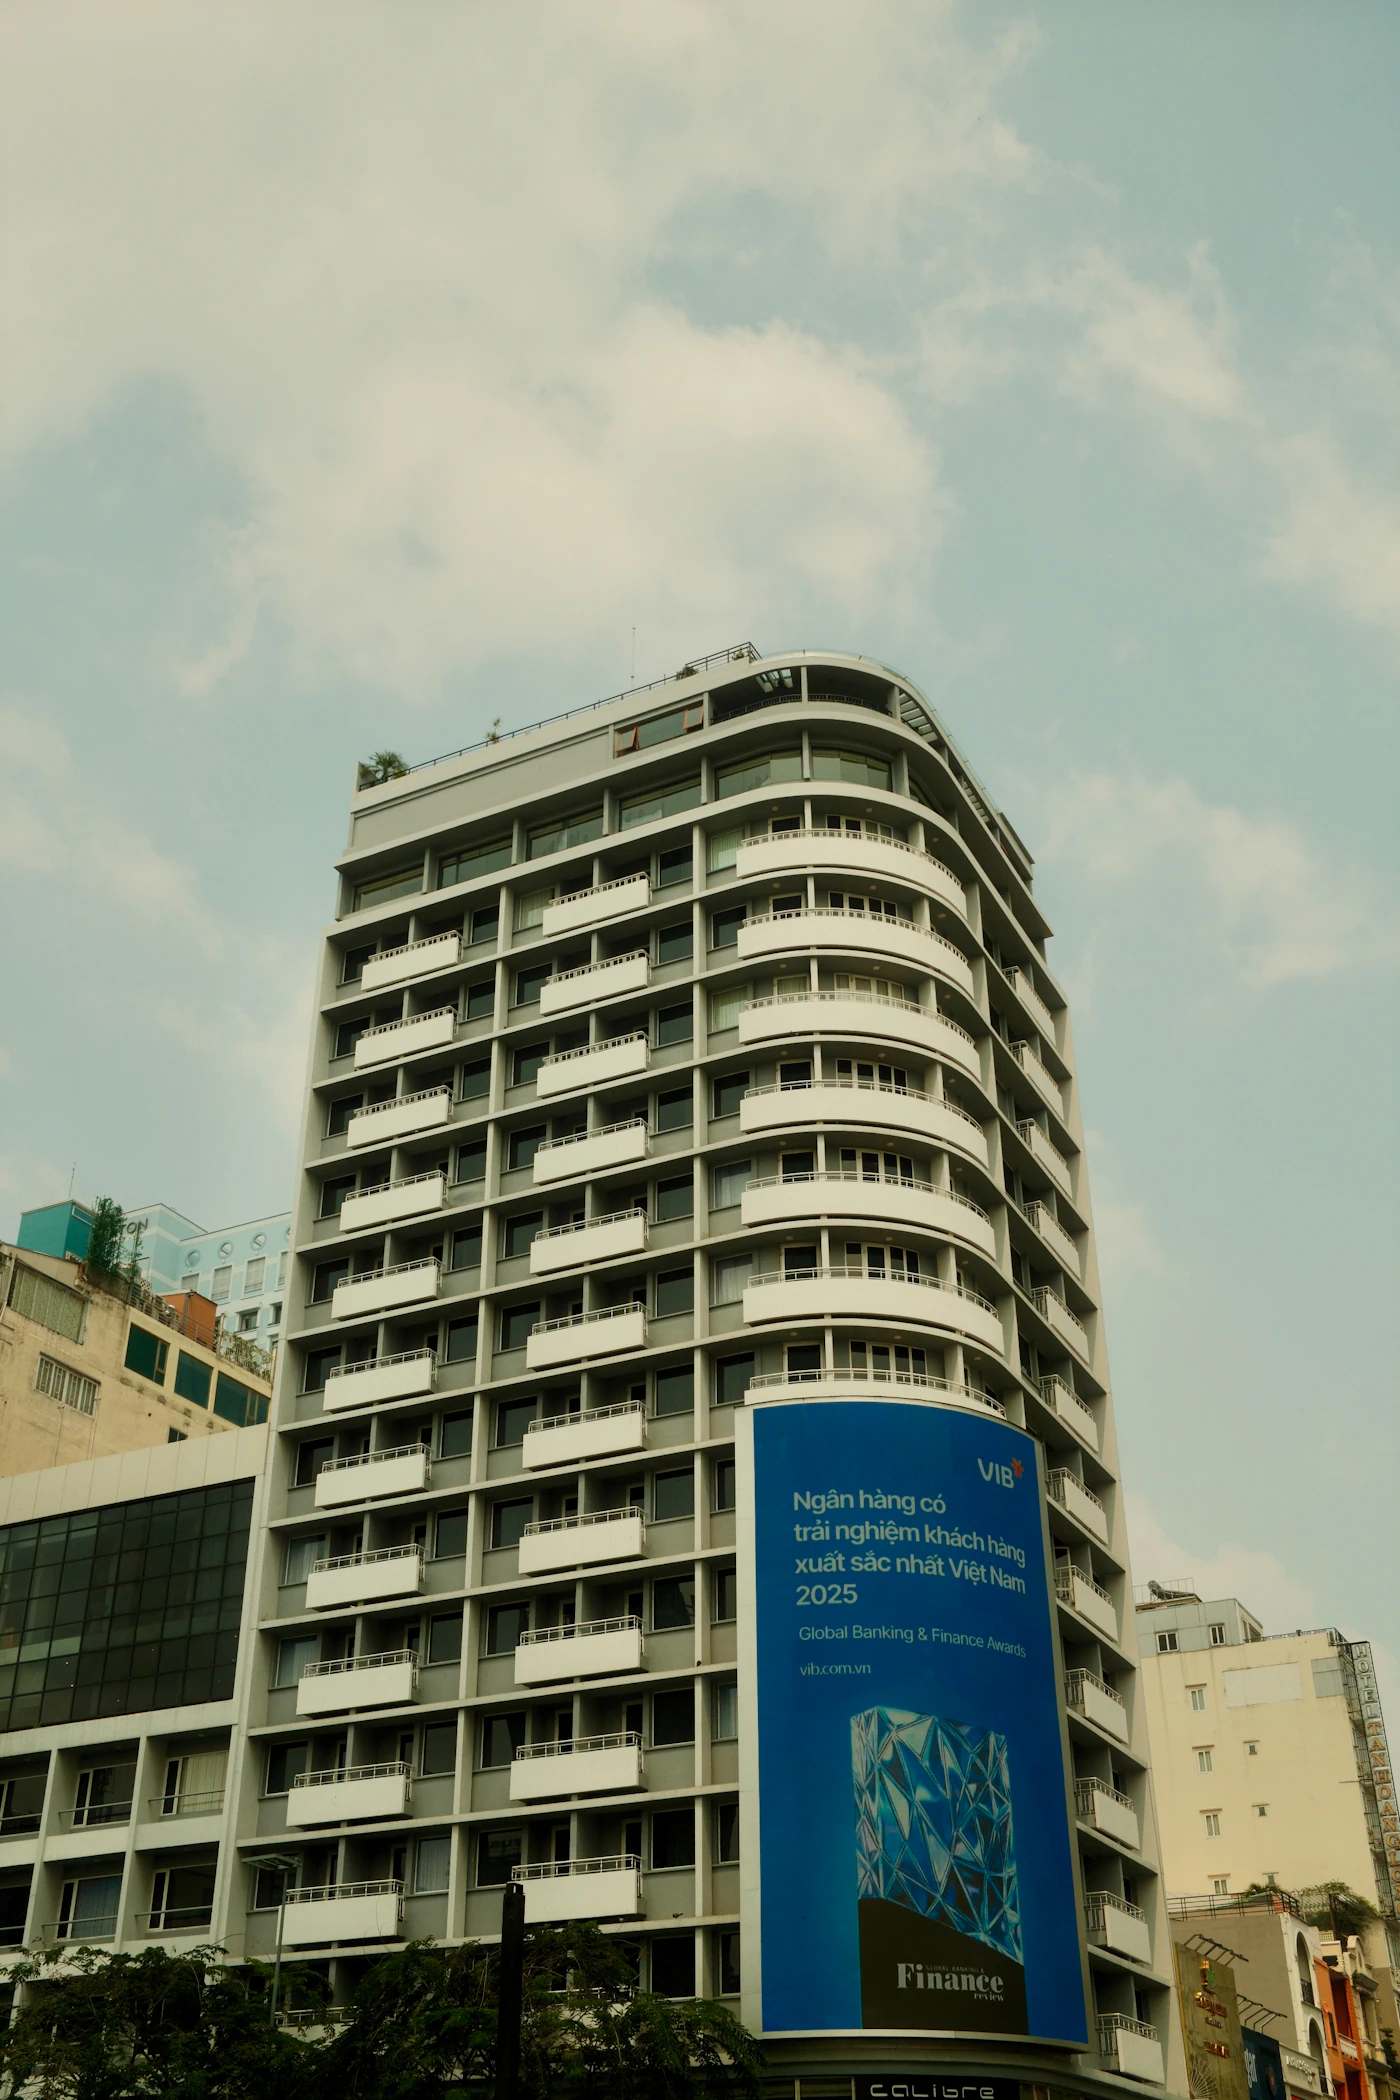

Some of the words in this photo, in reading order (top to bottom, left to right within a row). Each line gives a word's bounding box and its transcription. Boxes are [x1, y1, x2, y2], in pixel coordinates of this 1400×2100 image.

[977, 1458, 1015, 1489] VIB
[793, 1489, 855, 1515] Ngân
[859, 1489, 916, 1516] hàng
[920, 1494, 946, 1514] có
[793, 1519, 831, 1542] trải
[835, 1520, 920, 1545] nghiệm
[924, 1524, 985, 1552] khách
[988, 1535, 1026, 1568] hàng
[795, 1550, 846, 1574] xuất
[850, 1550, 891, 1572] sắc
[896, 1554, 945, 1576] nhất
[948, 1557, 987, 1586] Việt
[990, 1566, 1026, 1594] Nam
[795, 1583, 858, 1606] 2025
[799, 1625, 848, 1640] Global
[852, 1624, 914, 1643] Banking
[917, 1627, 928, 1641] &
[932, 1628, 984, 1648] Finance
[987, 1636, 1026, 1658] Awards
[800, 1662, 871, 1676] vib.com.vn
[1354, 1644, 1377, 1719] HOTEL
[896, 1963, 1004, 1993] Finance
[974, 1992, 1004, 2001] review
